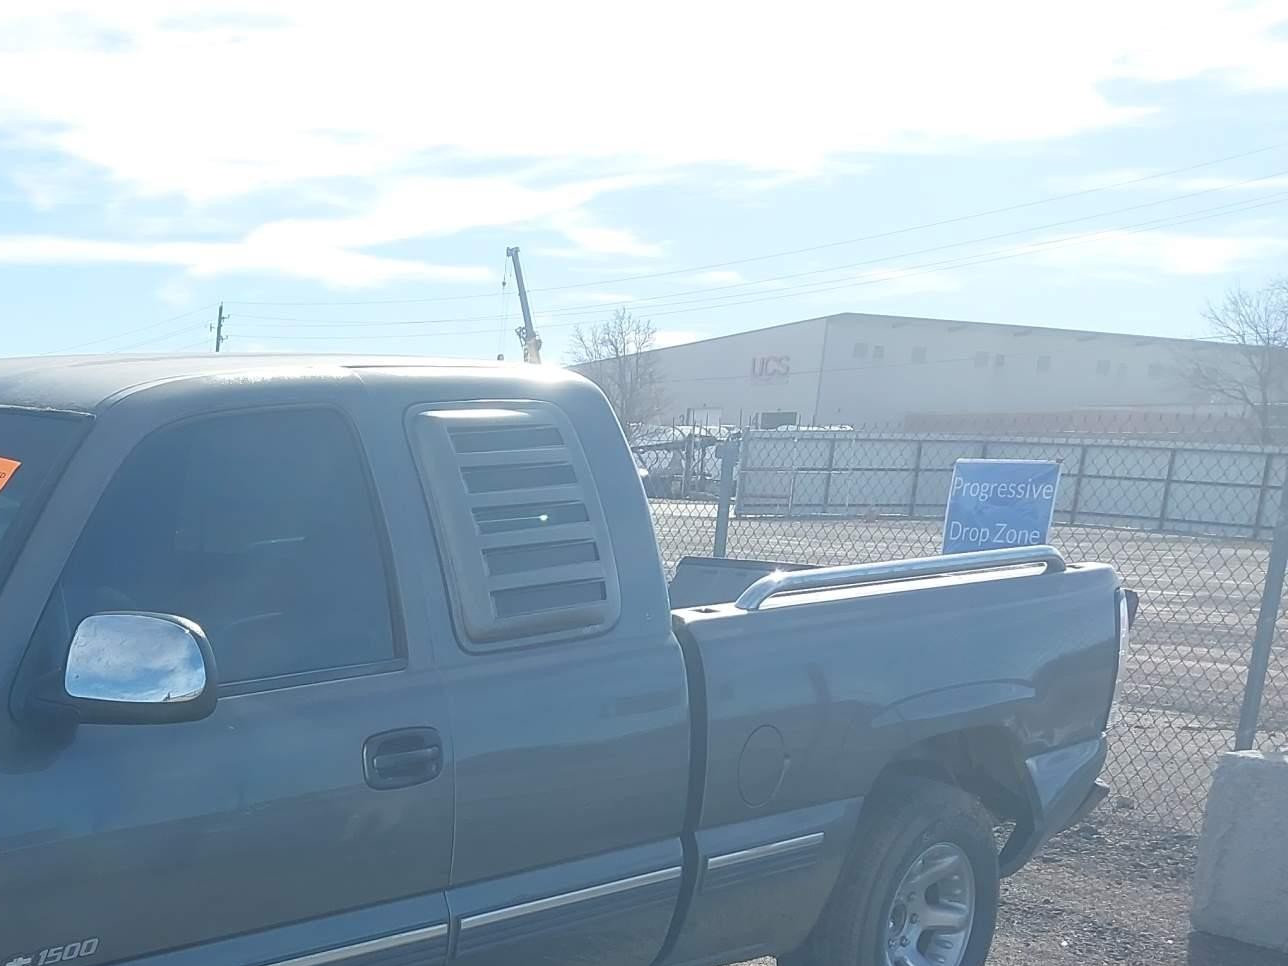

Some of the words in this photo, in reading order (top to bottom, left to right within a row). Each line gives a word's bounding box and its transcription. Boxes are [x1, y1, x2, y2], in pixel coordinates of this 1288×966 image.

[952, 477, 1054, 501] Progressive
[949, 521, 989, 546] Drop
[992, 523, 1040, 544] Zone
[37, 938, 99, 966] 1500
